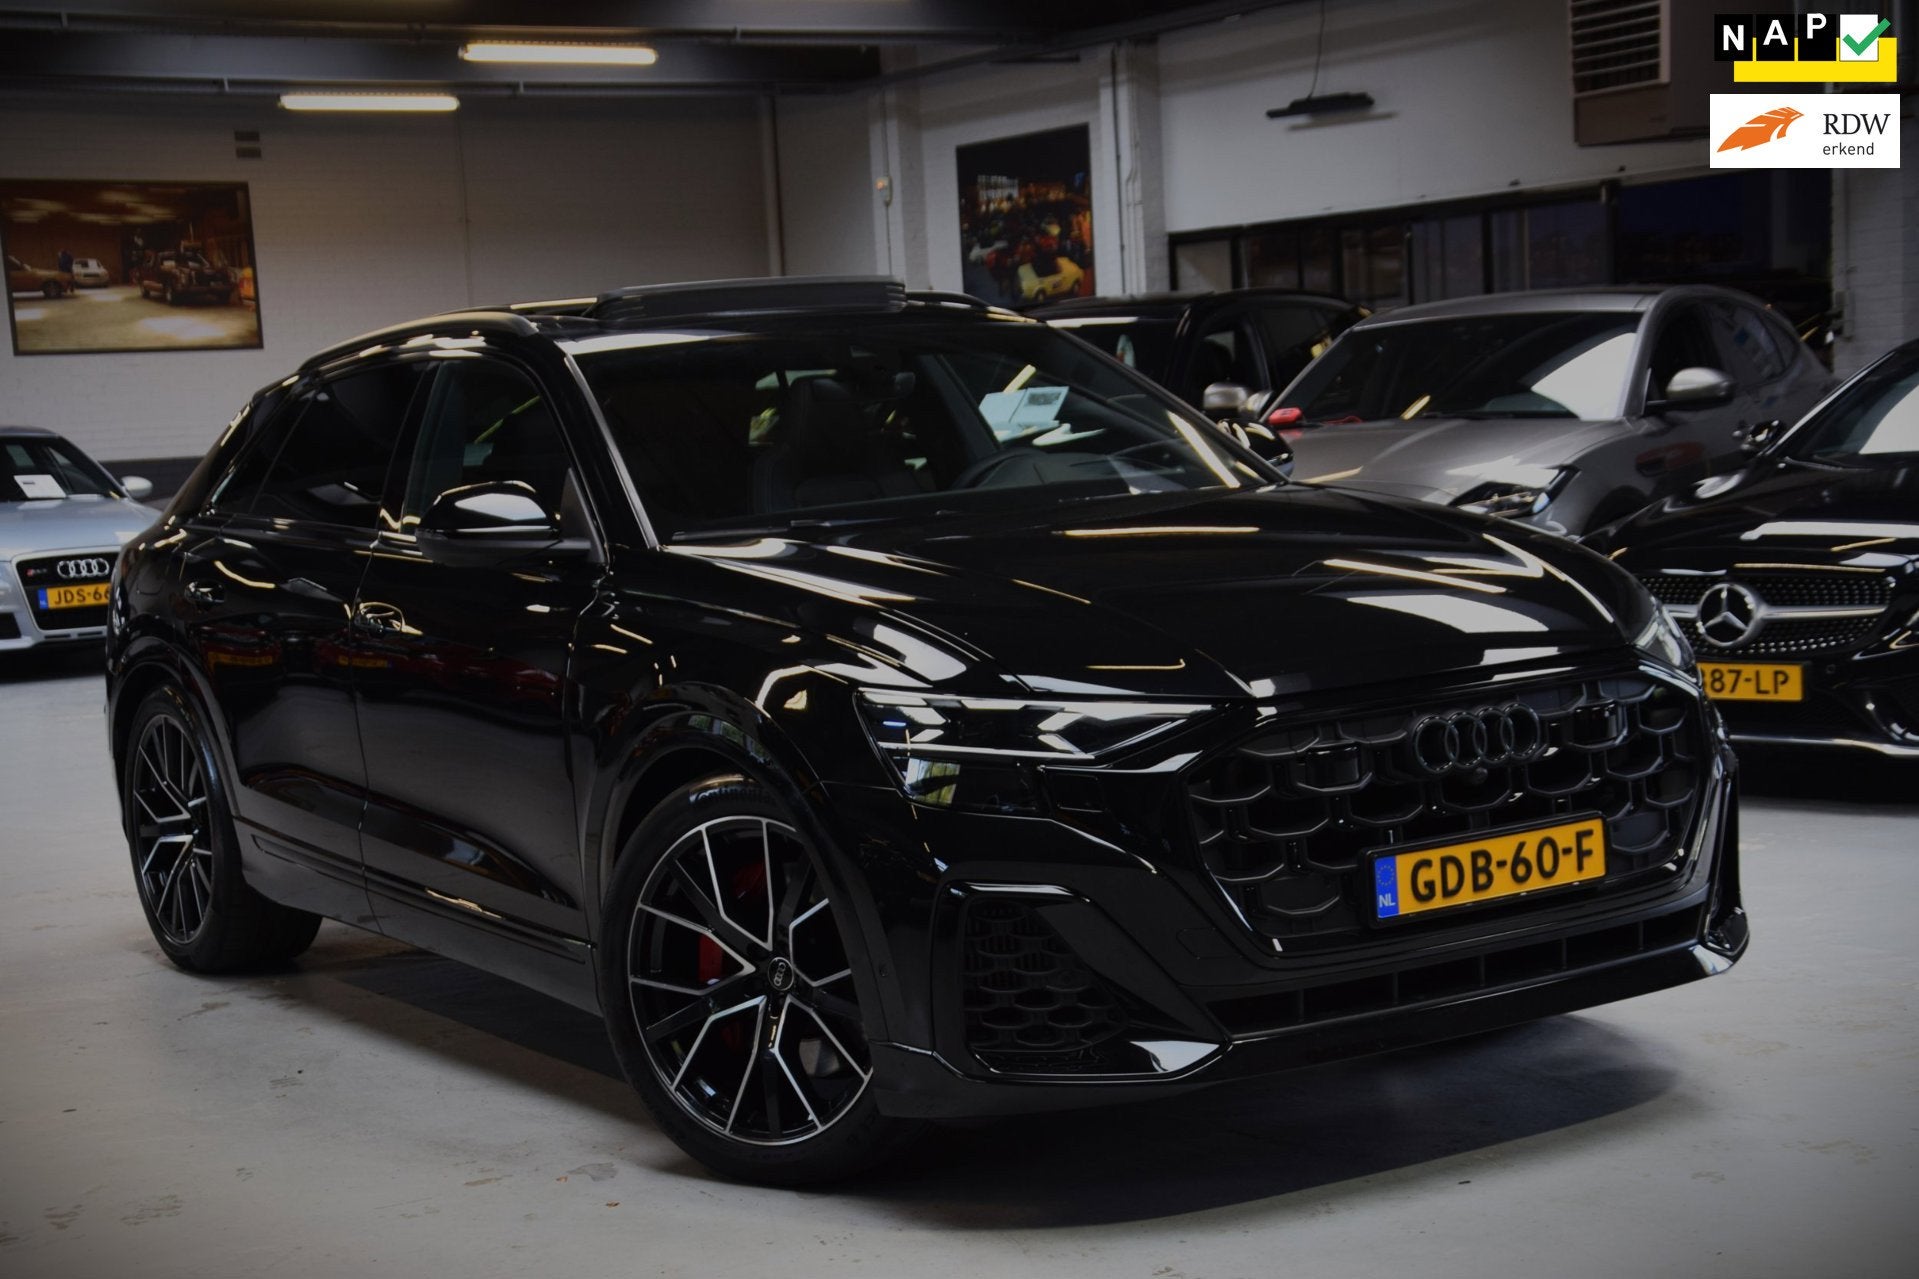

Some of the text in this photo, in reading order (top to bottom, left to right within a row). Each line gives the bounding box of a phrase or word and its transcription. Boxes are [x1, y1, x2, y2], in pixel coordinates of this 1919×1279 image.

[1701, 668, 1790, 694] 87-LP
[1410, 828, 1595, 903] GDB-60-F
[1378, 892, 1396, 908] NL
